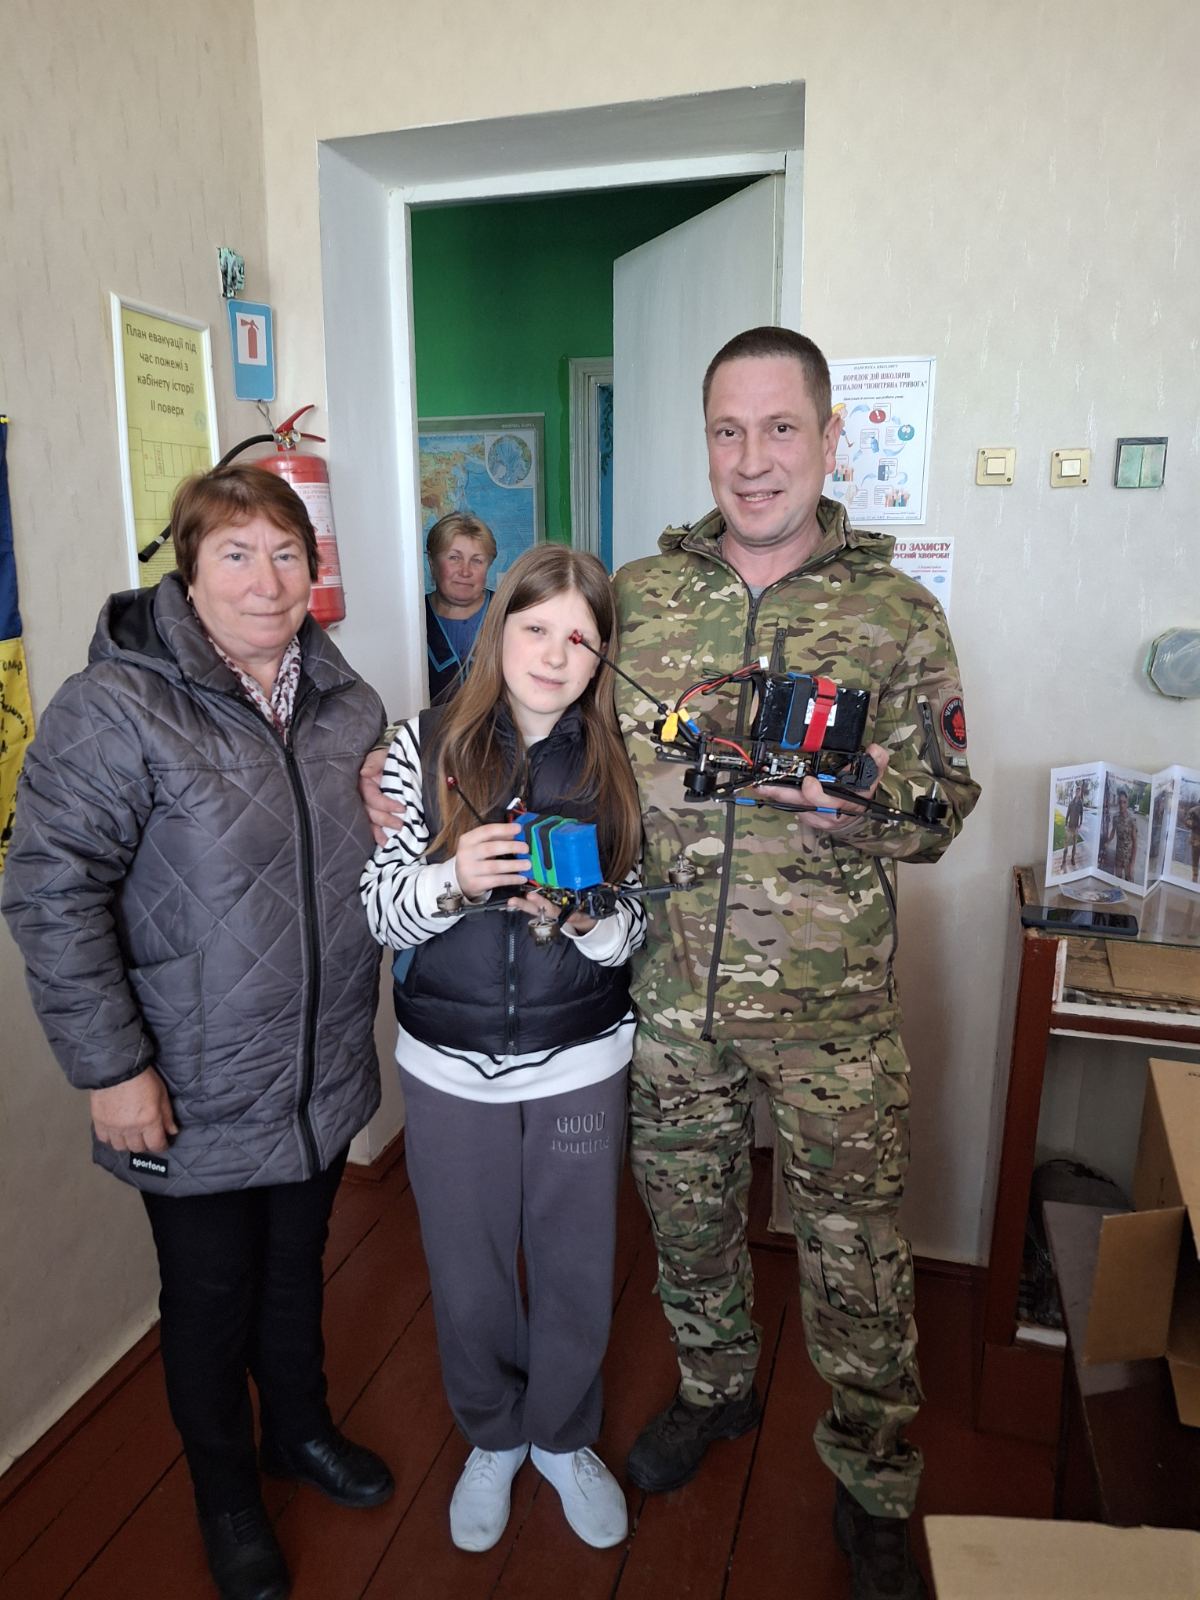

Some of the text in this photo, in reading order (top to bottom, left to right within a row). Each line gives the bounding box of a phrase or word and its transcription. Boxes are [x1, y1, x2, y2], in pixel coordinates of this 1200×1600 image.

[126, 323, 198, 354] План евакуації під
[139, 352, 189, 372] час пожежі з
[137, 373, 195, 396] кабінету історії
[843, 373, 869, 382] ПОРЯДОК
[157, 403, 185, 417] поверх
[895, 543, 951, 552] ГО ЗАХИСТУ
